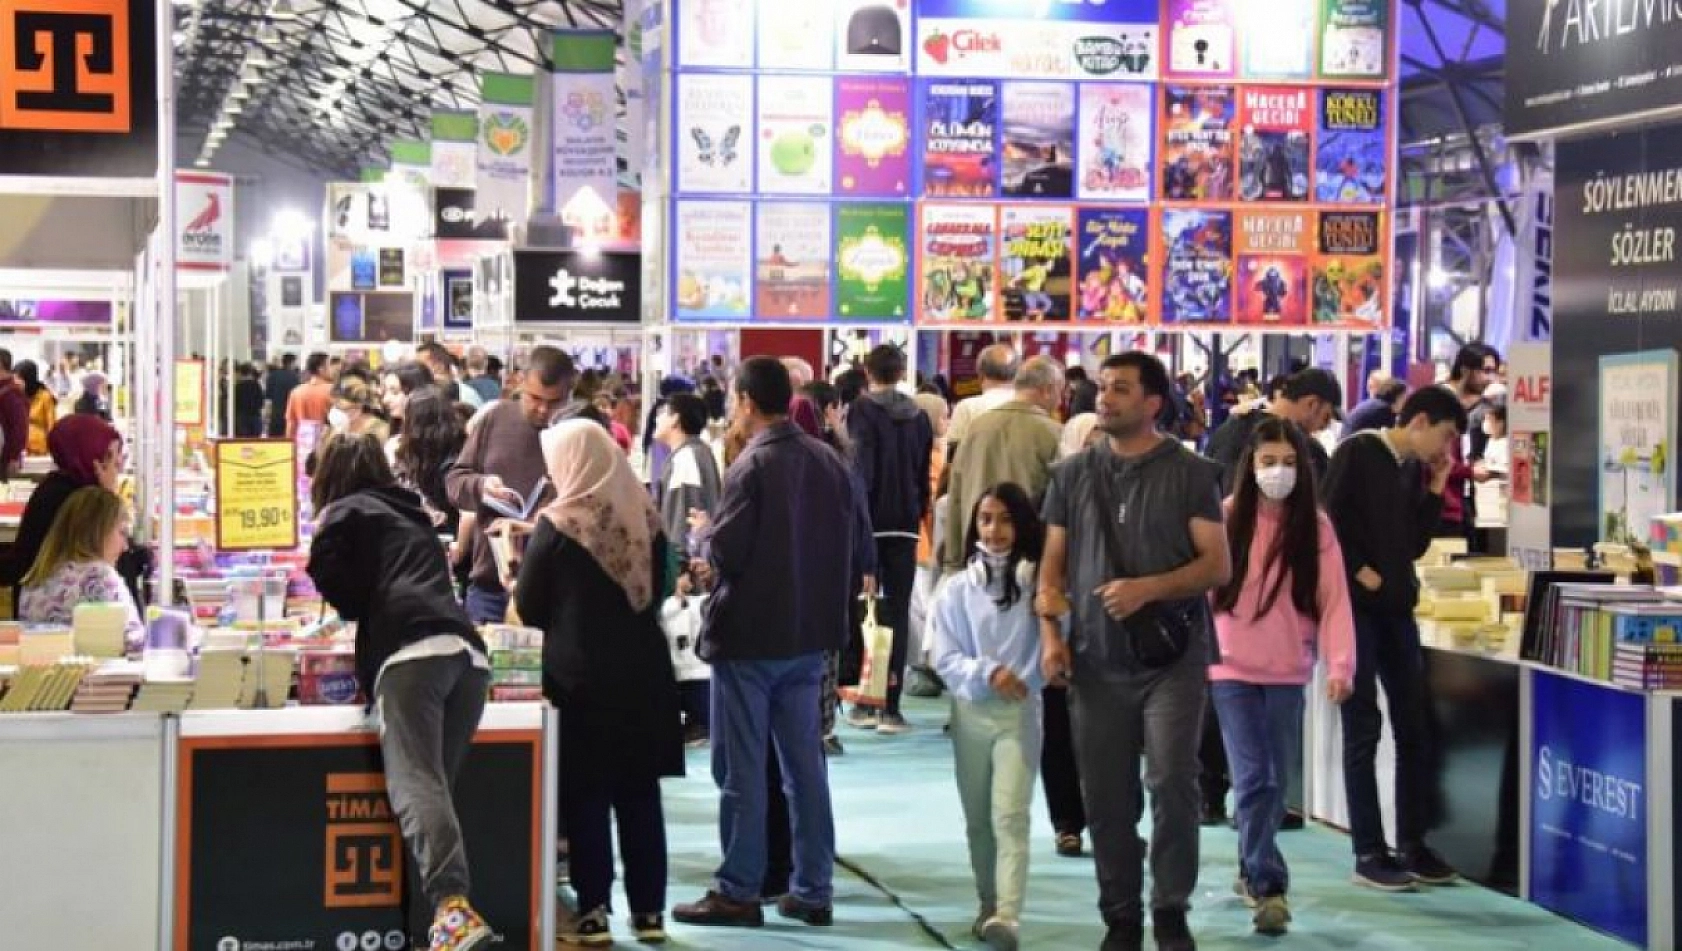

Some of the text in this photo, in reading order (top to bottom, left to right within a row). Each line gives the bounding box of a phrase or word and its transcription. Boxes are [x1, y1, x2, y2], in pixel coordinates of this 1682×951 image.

[1610, 223, 1674, 266] SÖZLER
[325, 794, 391, 819] TİMA
[1557, 759, 1641, 820] EVEREST
